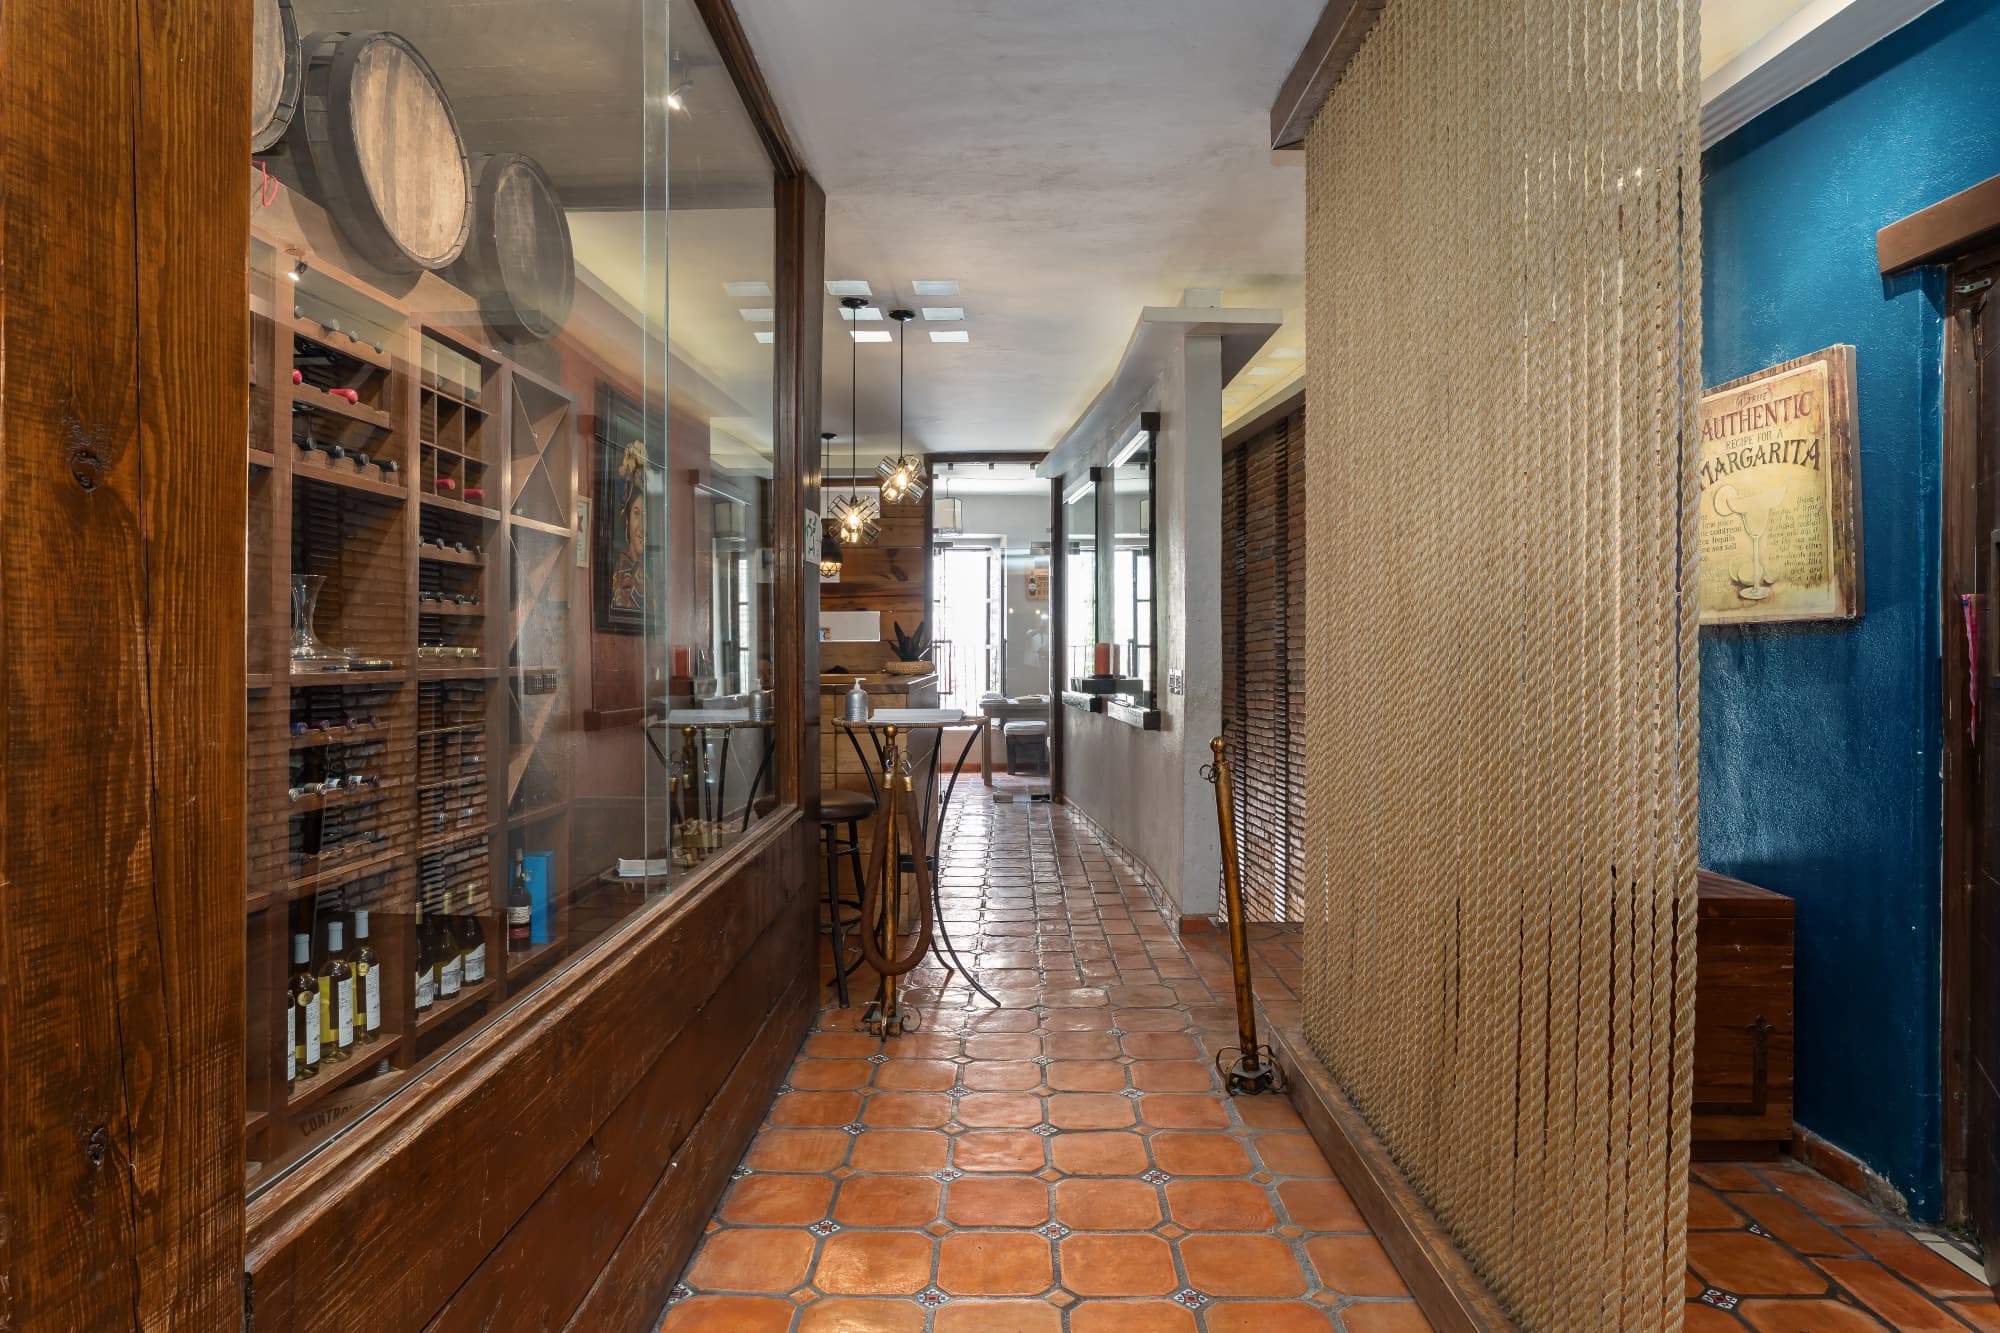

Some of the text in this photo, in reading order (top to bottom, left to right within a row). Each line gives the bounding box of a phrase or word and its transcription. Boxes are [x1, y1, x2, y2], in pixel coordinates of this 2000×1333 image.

[1701, 389, 1814, 442] AUTHENTIC
[1727, 428, 1783, 450] RECIPE FOR A
